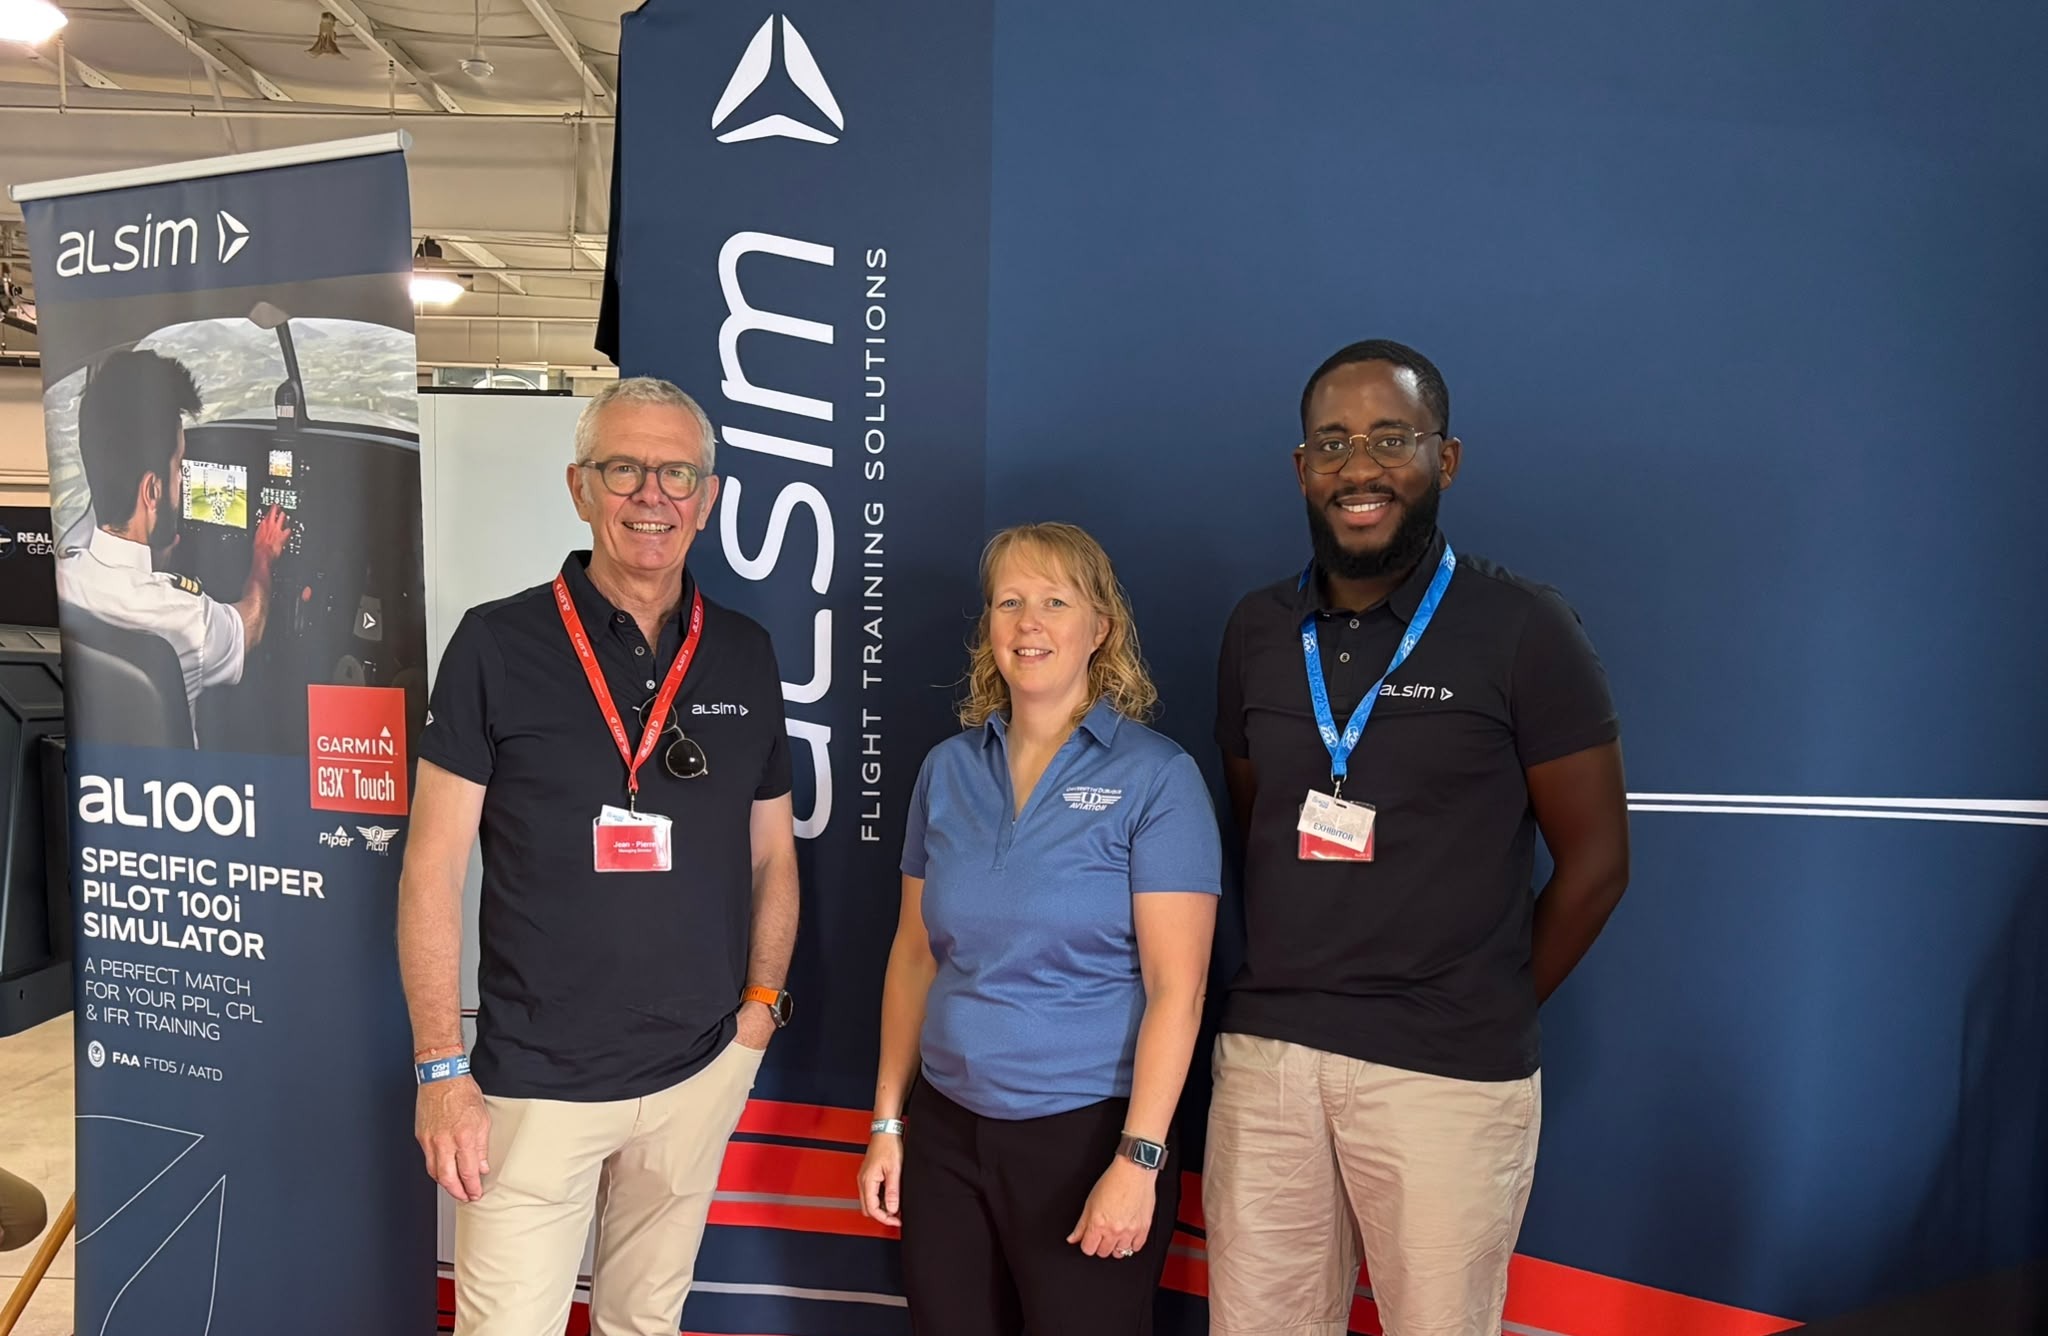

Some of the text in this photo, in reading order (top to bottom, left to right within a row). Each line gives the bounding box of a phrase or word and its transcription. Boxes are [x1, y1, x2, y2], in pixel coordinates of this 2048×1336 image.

[17, 532, 52, 543] REAL
[861, 247, 887, 841] FLIGHT TRAINING SOLUTIONS
[317, 736, 394, 756] GARMIN
[352, 769, 395, 801] Touch
[319, 832, 354, 848] Piper
[1313, 822, 1354, 842] EXHIBITOR
[82, 847, 325, 899] SPECIFIC PIPER
[83, 879, 240, 922] PILOT 100i
[83, 911, 266, 960] SIMULATOR
[84, 957, 251, 997] A PERFECT MATCH
[85, 980, 263, 1024] FOR YOUR PPL, CPL
[86, 1003, 221, 1041] & IFR TRAINING
[112, 1051, 141, 1068] FAA
[179, 1062, 185, 1075] /
[188, 1064, 223, 1082] AATD
[431, 1062, 450, 1072] OSH
